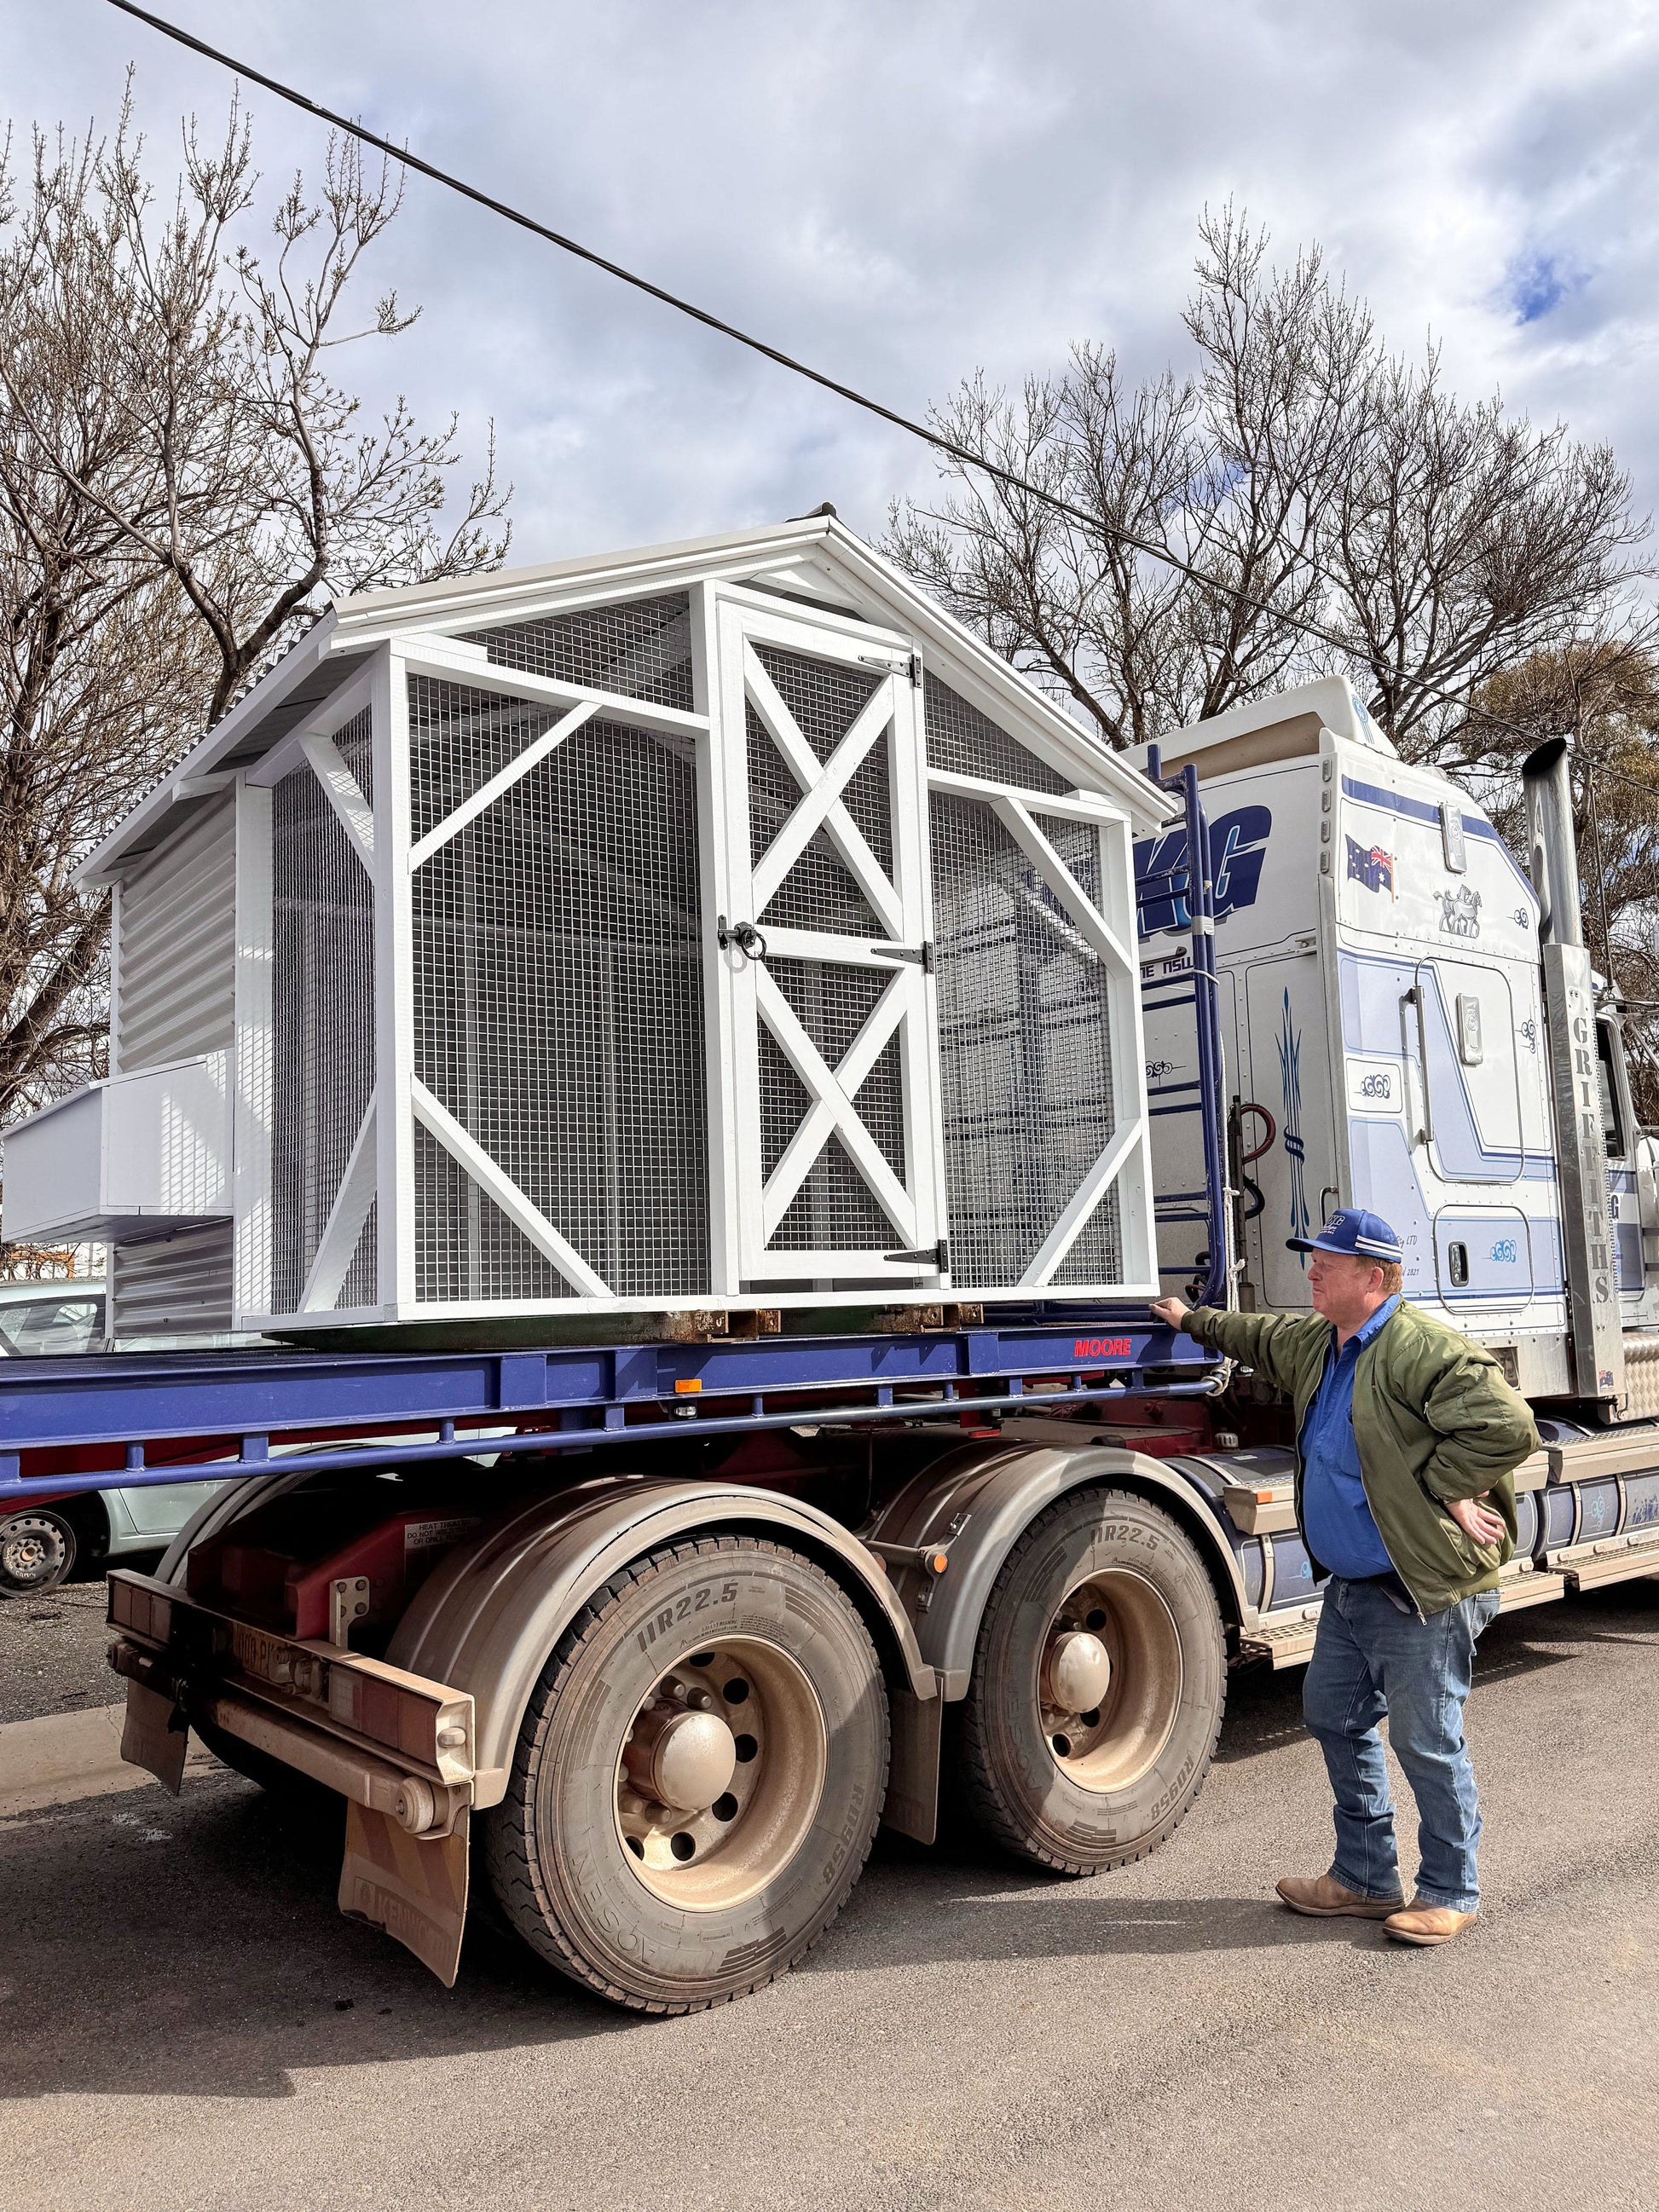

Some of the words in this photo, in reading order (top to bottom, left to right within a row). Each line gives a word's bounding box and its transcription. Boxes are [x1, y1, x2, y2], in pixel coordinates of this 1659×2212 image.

[1572, 1016, 1610, 1303] GRIFFITHS
[1407, 1235, 1418, 1245] LTD
[1074, 1337, 1132, 1357] MOORE
[419, 1522, 437, 1531] HEAT
